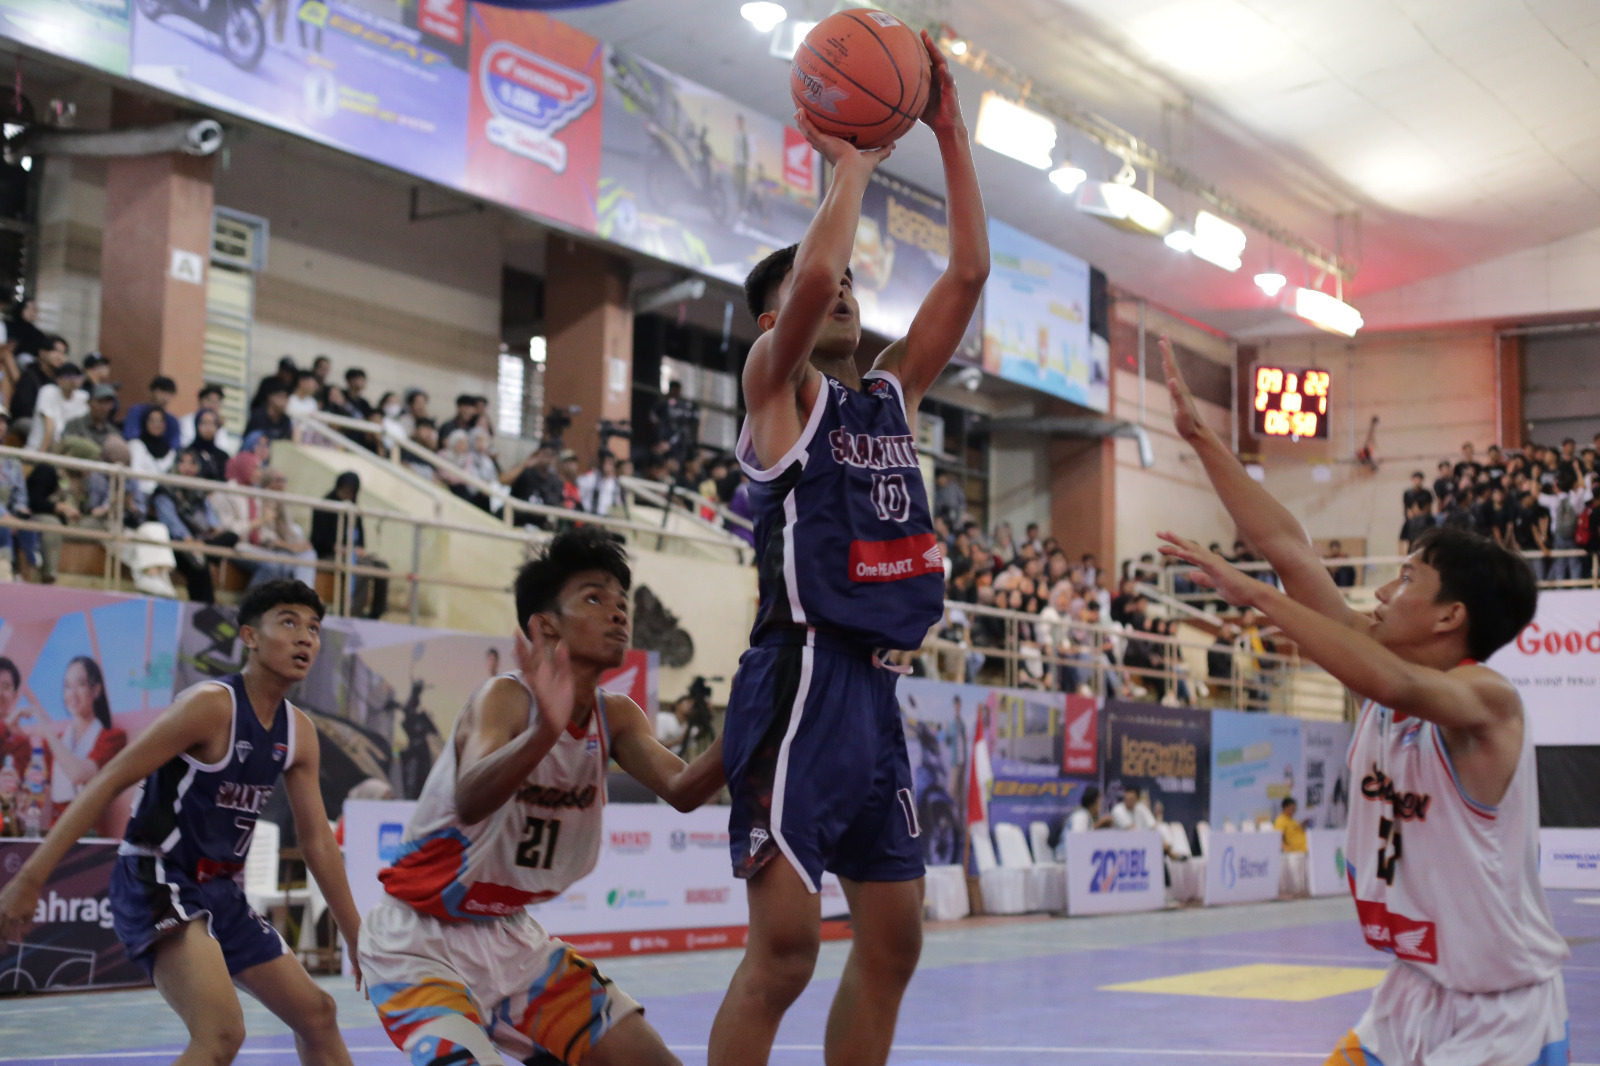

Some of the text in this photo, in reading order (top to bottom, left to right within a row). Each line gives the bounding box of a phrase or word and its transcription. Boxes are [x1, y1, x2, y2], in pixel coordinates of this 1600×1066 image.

[178, 258, 195, 277] A
[870, 473, 911, 523] 10
[234, 816, 258, 857] 7
[515, 816, 561, 870] 21
